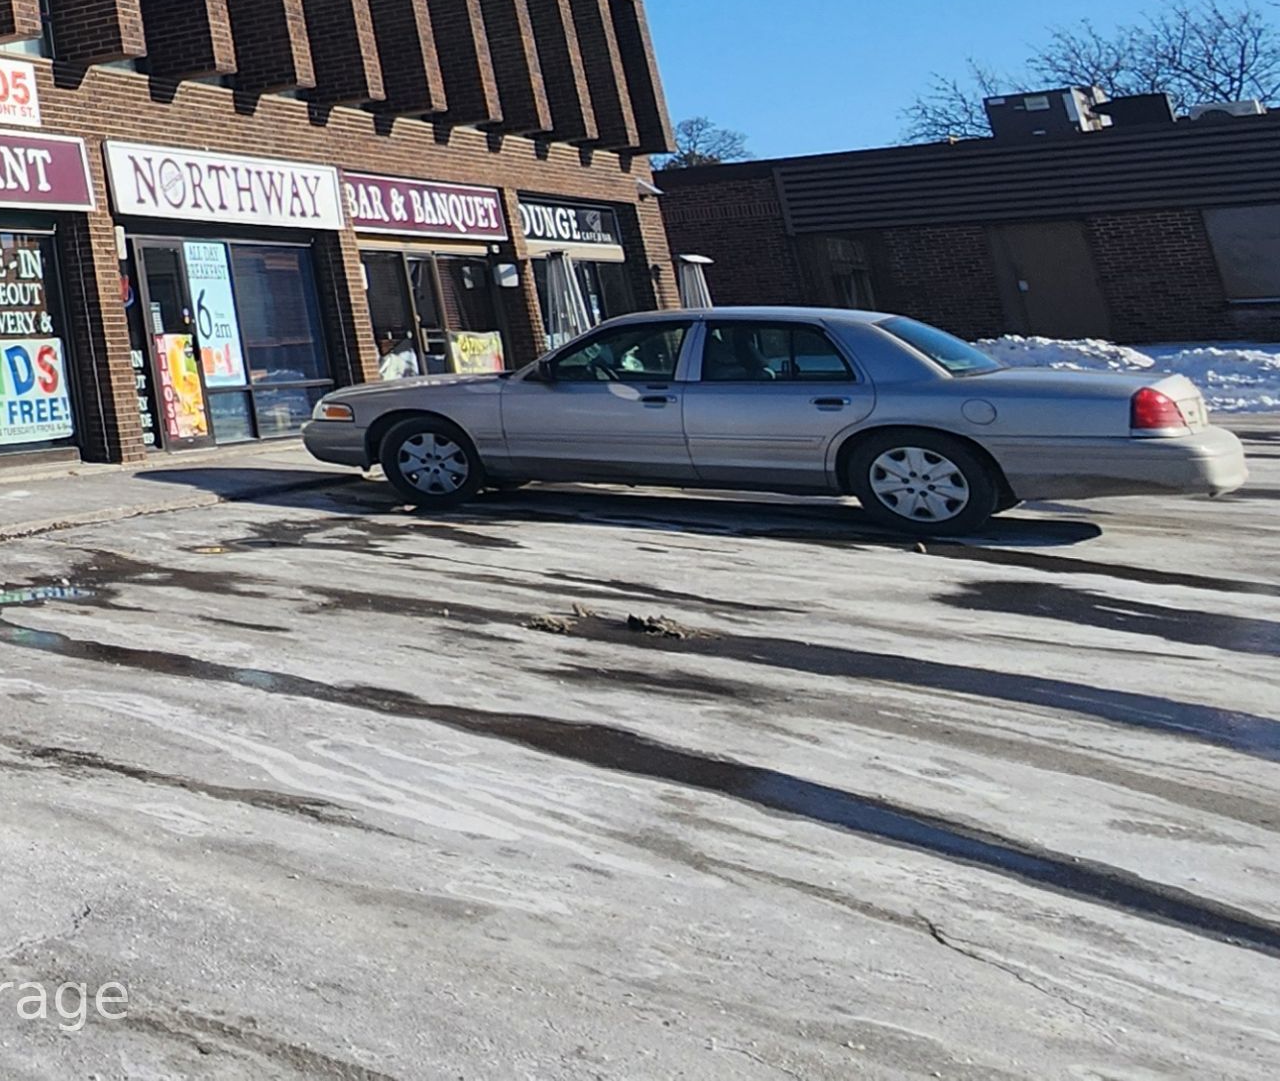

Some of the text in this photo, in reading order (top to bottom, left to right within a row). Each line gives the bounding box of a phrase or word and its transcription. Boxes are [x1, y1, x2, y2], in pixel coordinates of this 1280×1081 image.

[128, 155, 321, 218] NORTHWAY
[344, 182, 499, 233] BAR & BANQUET
[17, 249, 43, 280] IN
[41, 311, 54, 333] &
[197, 289, 213, 340] 6
[215, 323, 232, 339] am
[156, 337, 180, 439] MIMOSA
[8, 397, 70, 425] FREE!
